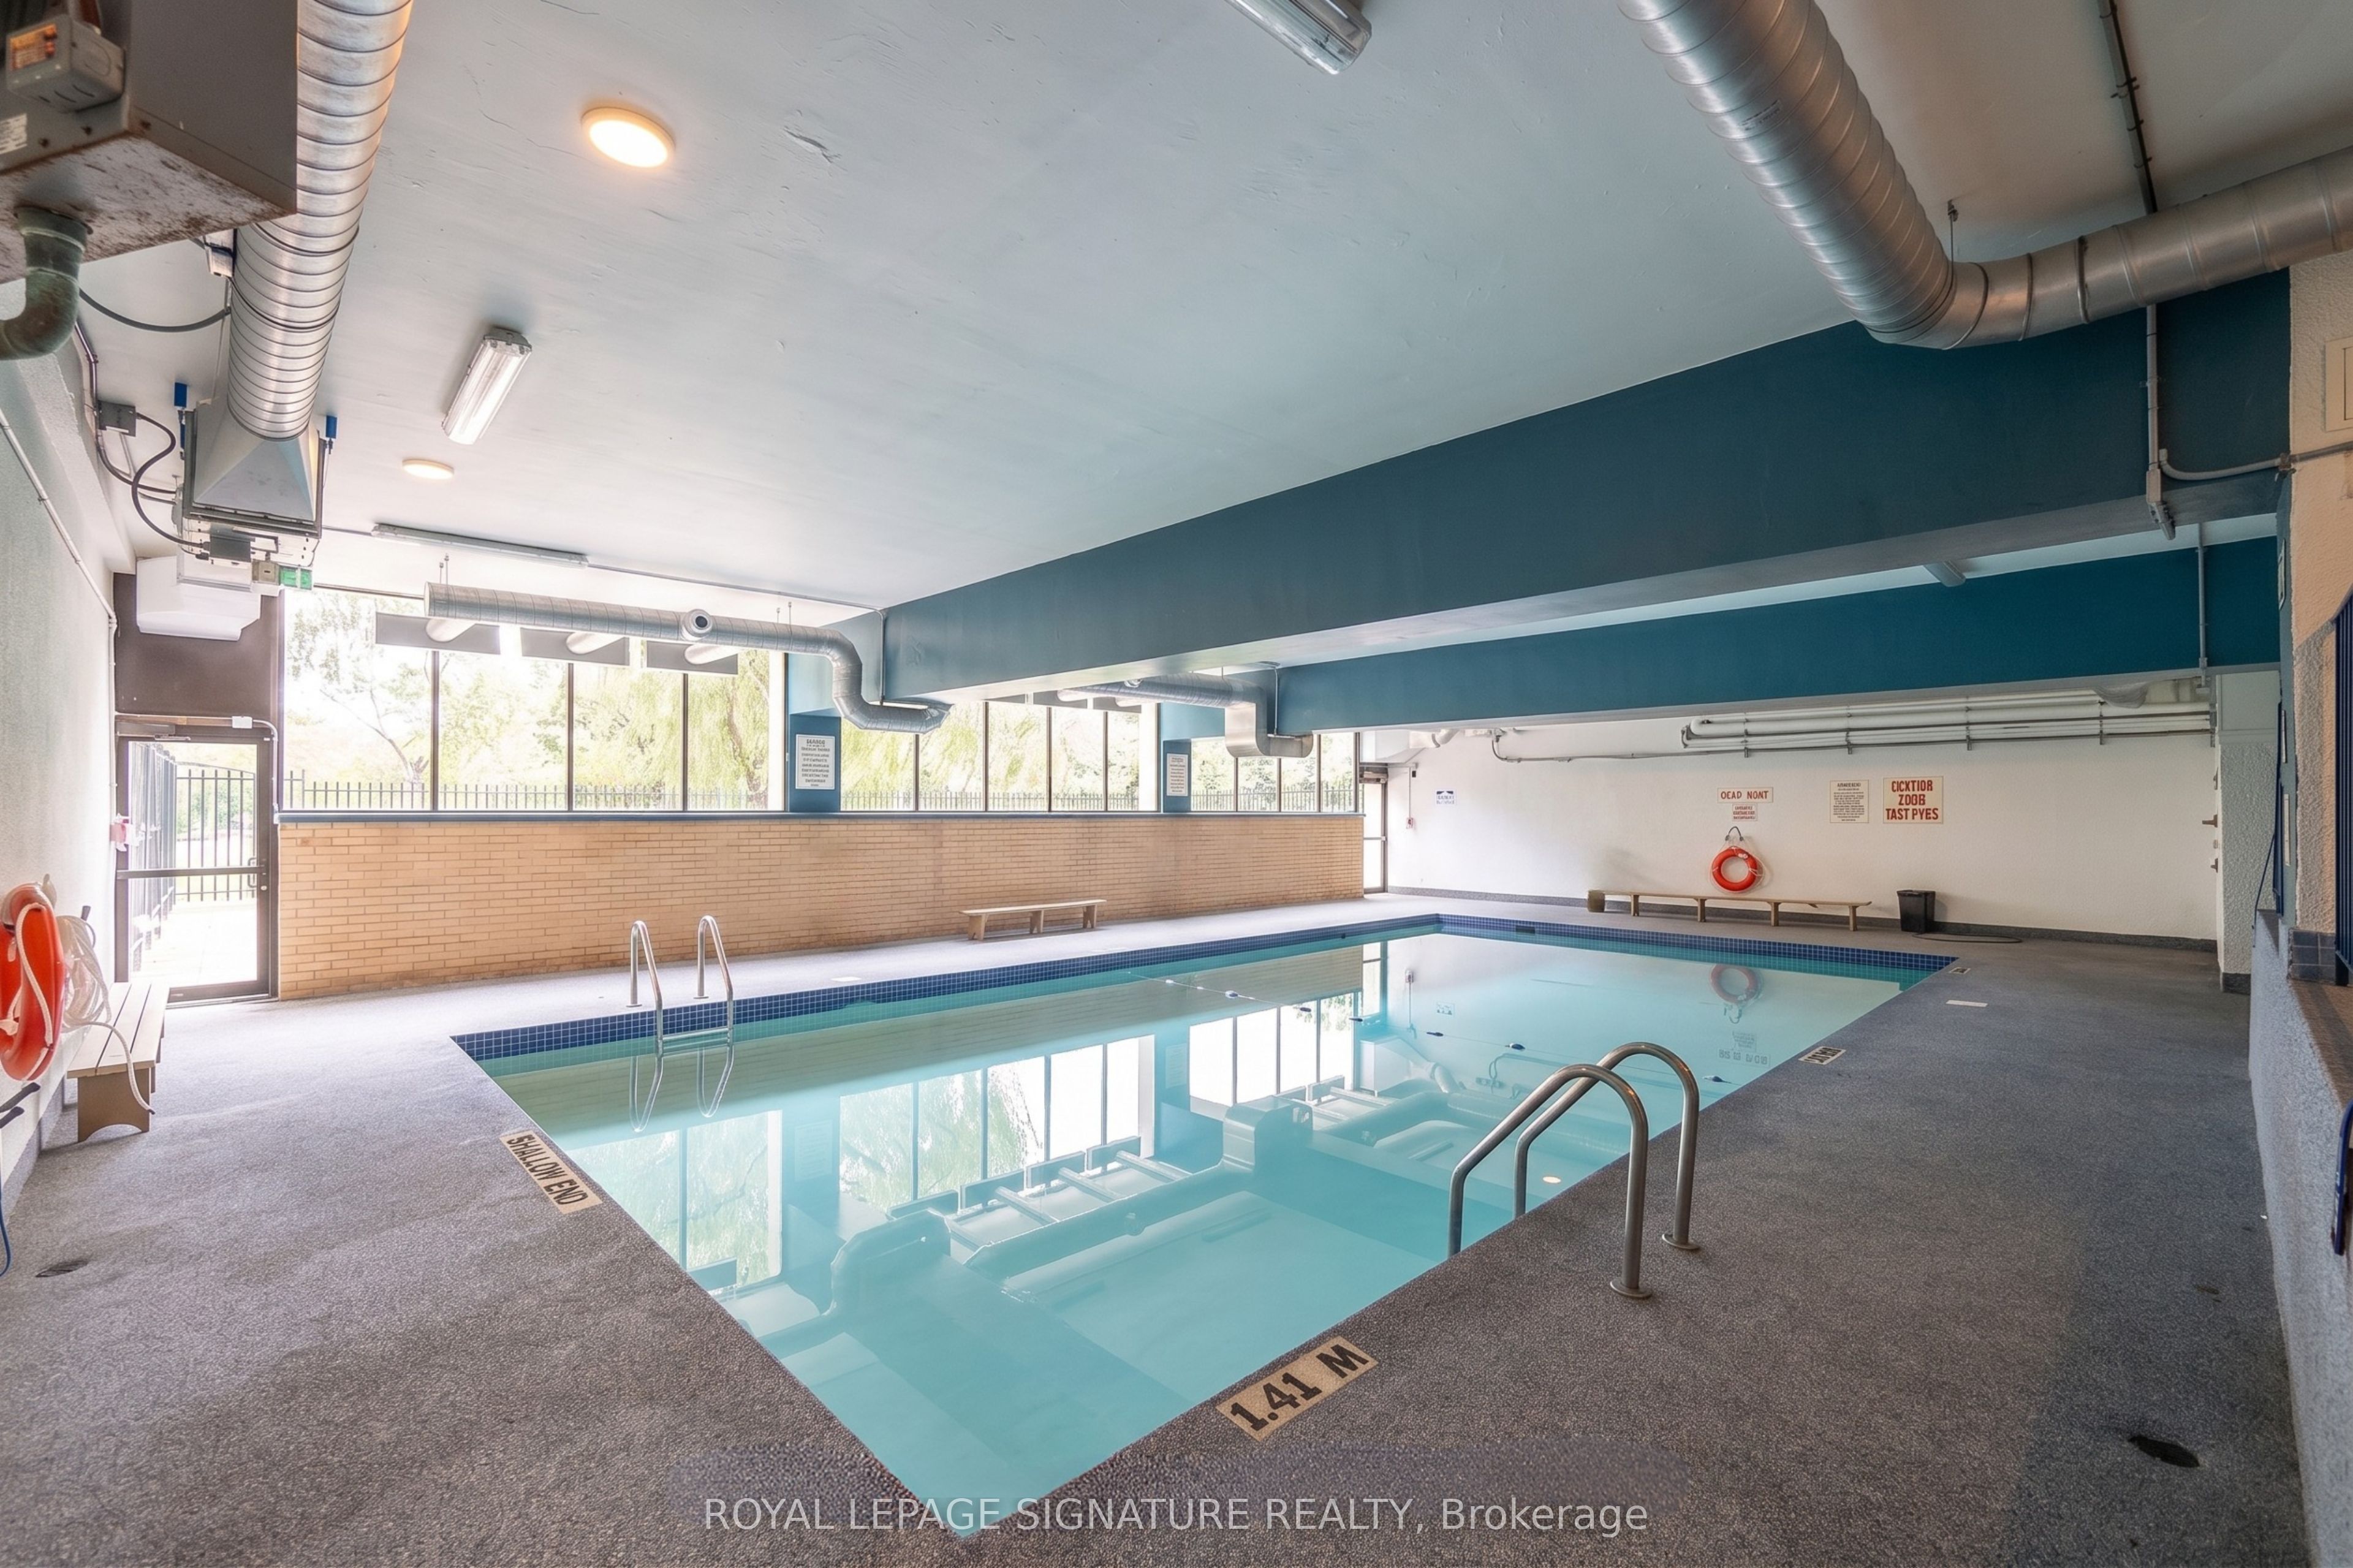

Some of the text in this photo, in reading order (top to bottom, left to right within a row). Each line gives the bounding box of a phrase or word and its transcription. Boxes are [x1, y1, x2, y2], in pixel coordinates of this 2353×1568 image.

[1885, 808, 1939, 820] TAST PYES
[506, 1134, 589, 1205] SHALLOW END
[1230, 1344, 1370, 1431] 1.41 M
